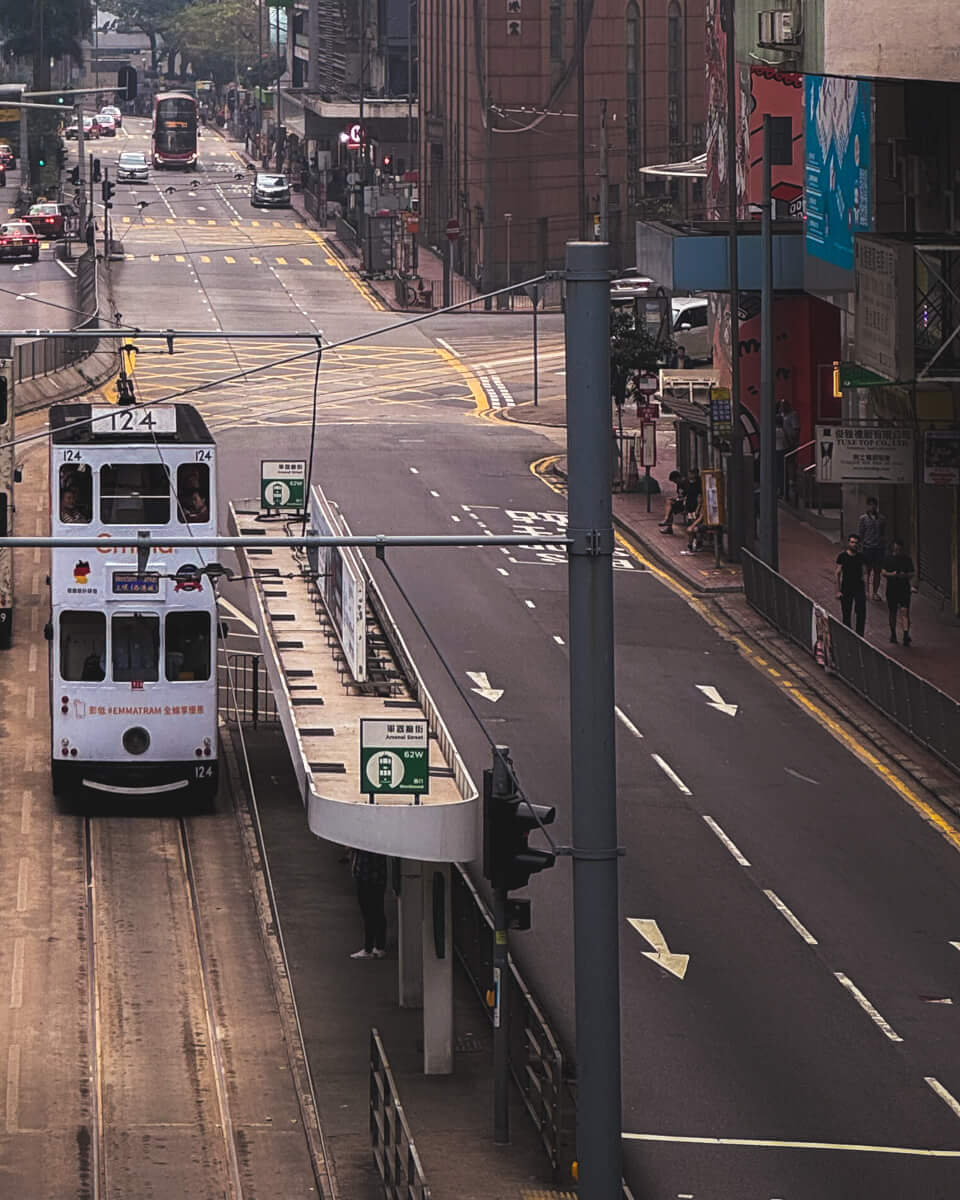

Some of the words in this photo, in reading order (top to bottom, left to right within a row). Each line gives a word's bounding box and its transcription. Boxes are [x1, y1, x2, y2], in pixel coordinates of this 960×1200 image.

[111, 410, 156, 431] 124
[64, 450, 82, 461] 124
[195, 450, 213, 461] 124
[404, 751, 424, 759] 62W
[195, 766, 213, 778] 124
